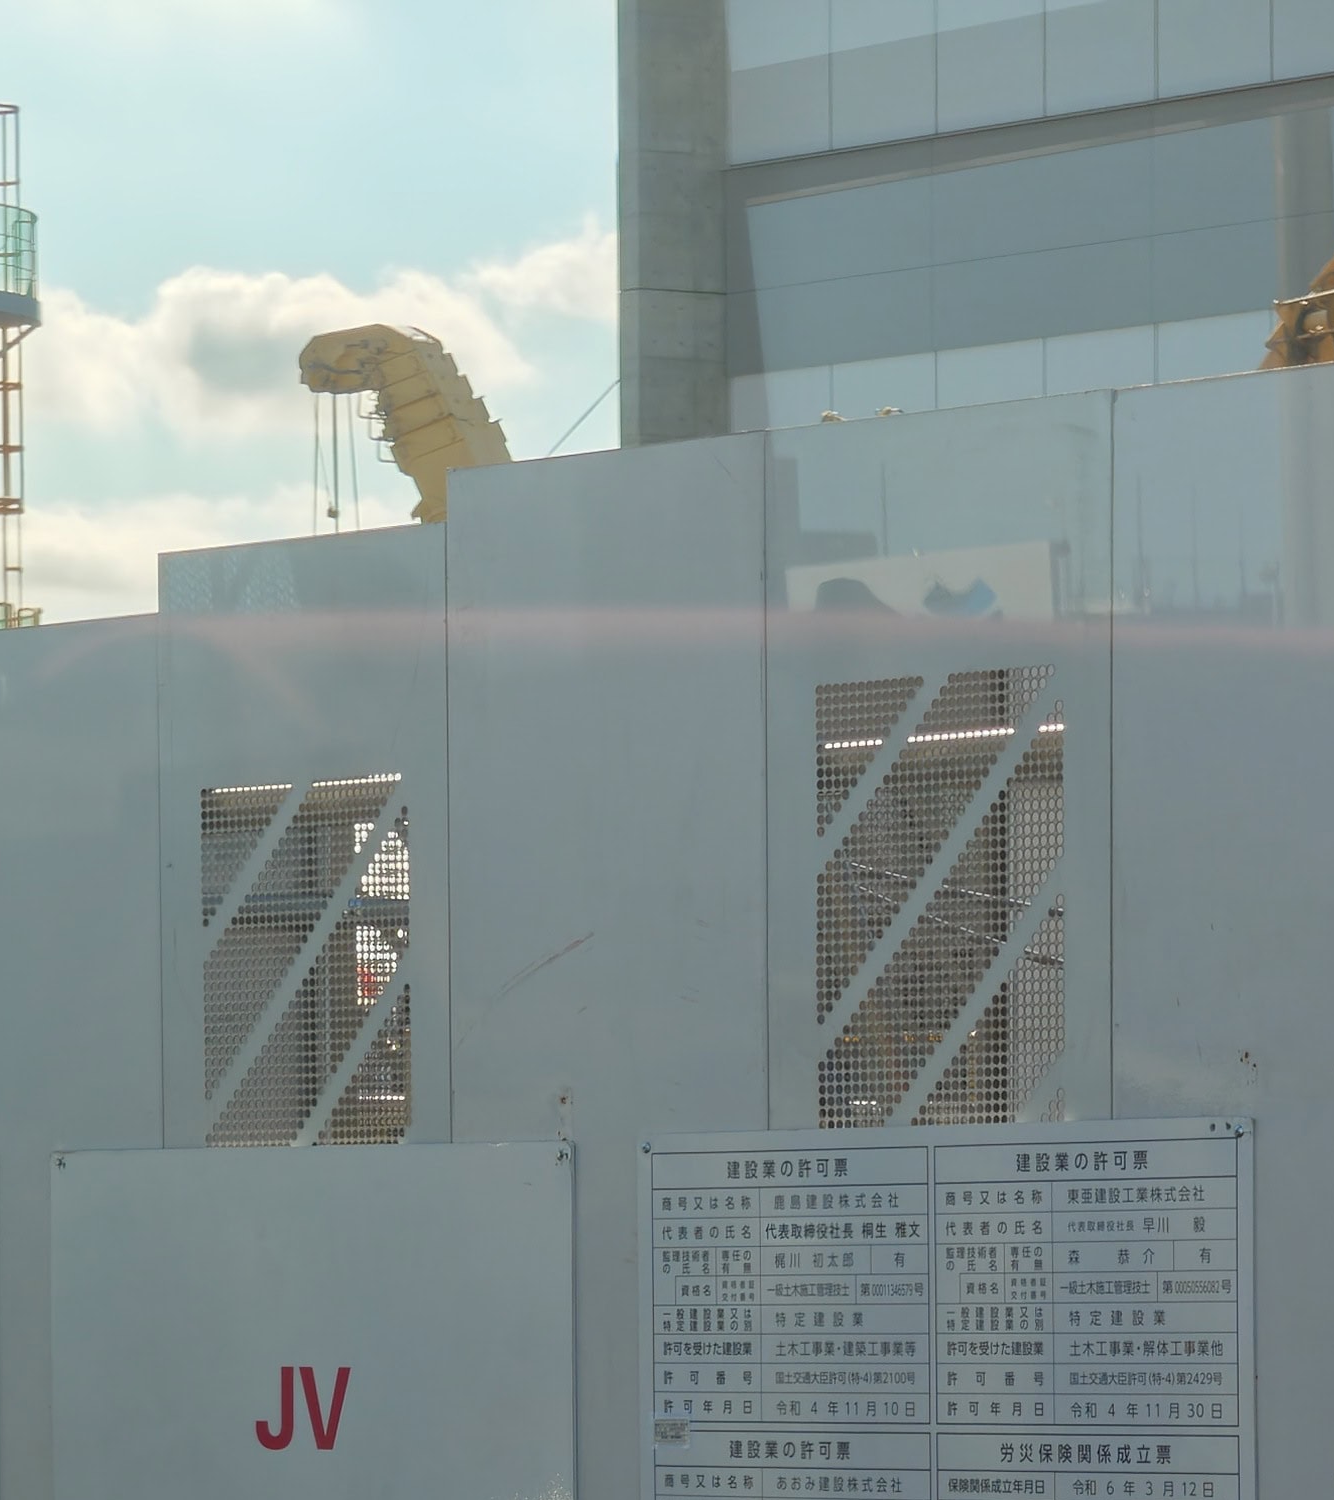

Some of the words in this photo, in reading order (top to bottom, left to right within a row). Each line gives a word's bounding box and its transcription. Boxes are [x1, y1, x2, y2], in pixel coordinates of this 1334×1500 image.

[727, 1158, 848, 1179] 建設業の許可票
[1017, 1150, 1148, 1172] 建設業の許可票
[774, 1192, 899, 1210] 鹿島建設株式会社
[946, 1189, 1042, 1205] 商号又は名称
[1068, 1185, 1204, 1204] 東亜建設工業株式会社
[662, 1196, 751, 1211] 商号又は名称
[766, 1223, 853, 1239] 代表取締役社長
[862, 1222, 886, 1238] 桐生
[895, 1221, 920, 1238] 雅文
[946, 1219, 1042, 1236] 代表者の氏名
[1068, 1220, 1134, 1232] 代表取締役社長
[1143, 1217, 1169, 1232] 早川
[1194, 1216, 1205, 1232] 毅
[662, 1225, 751, 1240] 代表者の氏名
[663, 1250, 709, 1262] 監理技術者
[722, 1250, 751, 1262] 専任の
[894, 1252, 905, 1267] 有
[946, 1247, 997, 1259] 監理技術者
[1011, 1246, 1042, 1258] 専任の
[1068, 1250, 1080, 1264] 森
[1118, 1248, 1154, 1264] 恭介
[1200, 1248, 1211, 1263] 有
[663, 1263, 710, 1274] の氏名
[722, 1263, 751, 1273] 有無
[946, 1259, 997, 1271] の氏名
[1011, 1259, 1042, 1271] 有無
[681, 1284, 711, 1297] 資格名
[967, 1282, 998, 1294] 資格名
[1061, 1281, 1150, 1295] 一級土木施工管理技士
[663, 1308, 751, 1319] 一般建設業又は
[776, 1312, 863, 1327] 特定建設業
[947, 1307, 1042, 1318] 一般建設業又は
[1069, 1310, 1165, 1326] 特定建設業
[663, 1320, 752, 1331] 特定建設業の別
[947, 1319, 1044, 1331] 特定建設業の別
[664, 1341, 752, 1356] 許可を受けた建設業
[776, 1341, 915, 1356] 土木工事業・建築工事業等
[947, 1342, 1043, 1356] 許可を受けた建設業
[1070, 1340, 1223, 1357] 土木工事業・解体工事業他
[664, 1370, 751, 1385] 許可番号
[947, 1371, 1044, 1385] 許可番号
[256, 1367, 351, 1450] JV
[664, 1400, 752, 1414] 許可年月日
[947, 1402, 1044, 1416] 許可年月日
[730, 1440, 850, 1460] 建設業の許可票
[1000, 1443, 1171, 1464] 労災保険関係成立票
[665, 1475, 753, 1489] 商号又は名称
[777, 1477, 902, 1492] あおみ建設株式会社
[948, 1479, 1045, 1494] 保険関係成立年月日
